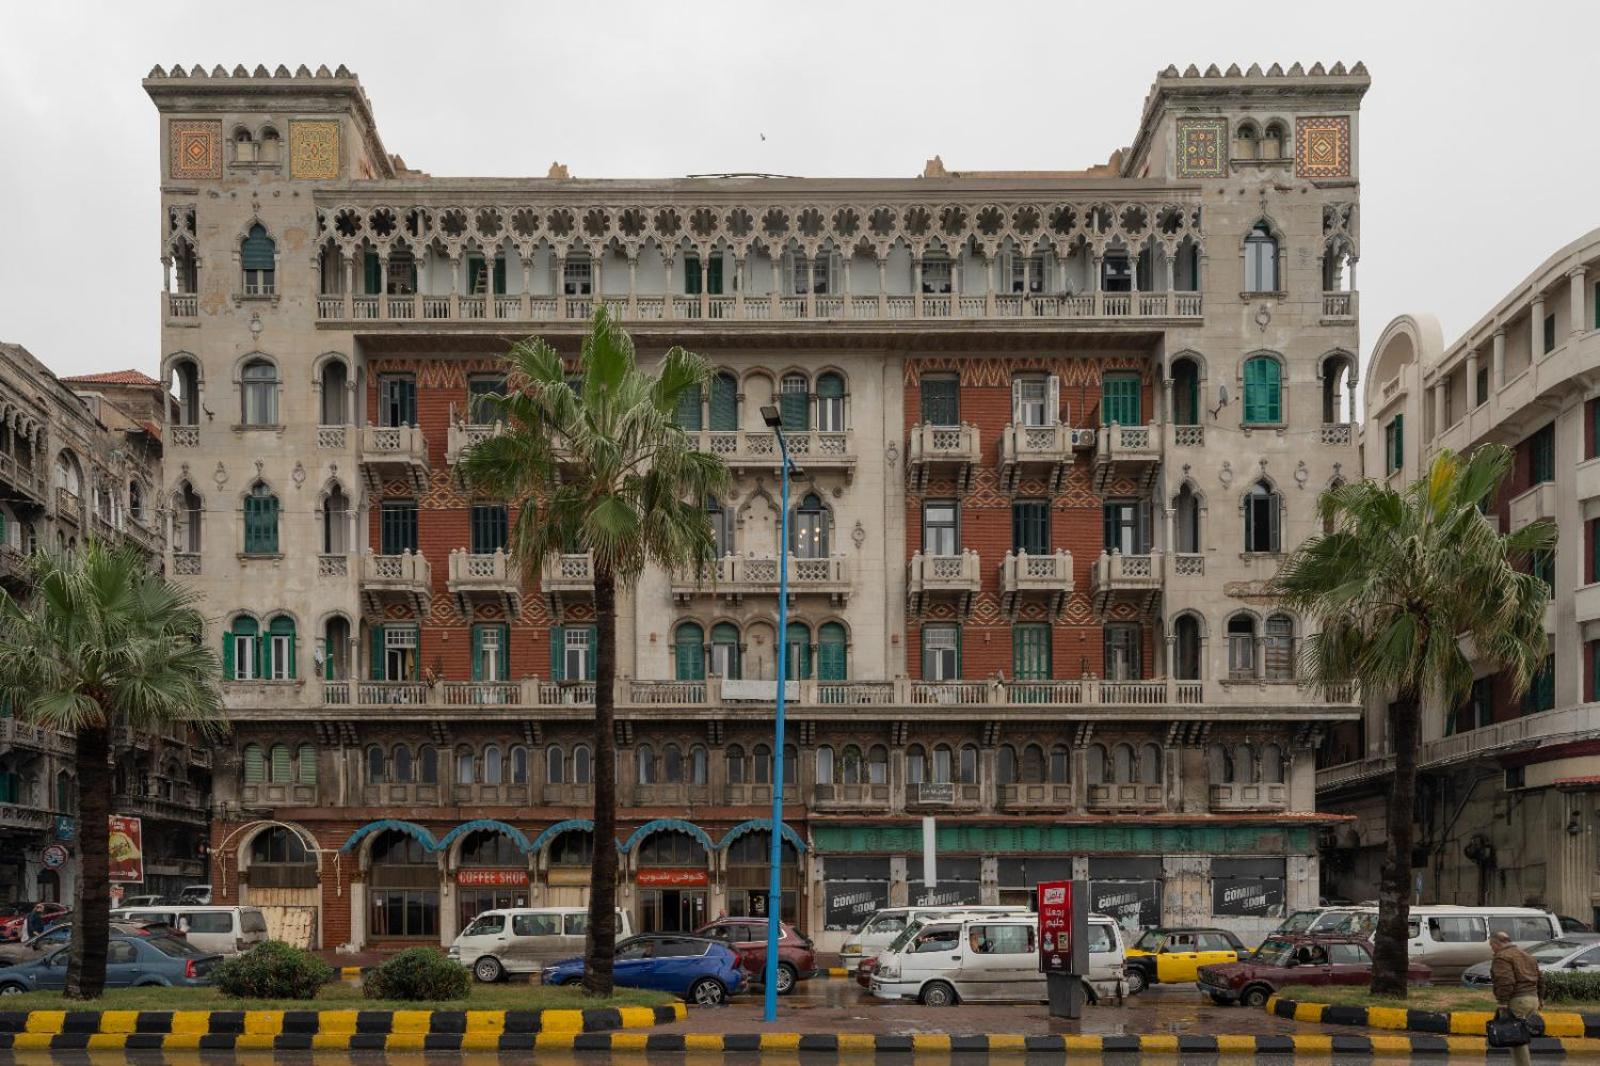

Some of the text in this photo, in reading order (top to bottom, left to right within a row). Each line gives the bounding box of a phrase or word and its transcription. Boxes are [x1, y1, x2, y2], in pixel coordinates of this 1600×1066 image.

[460, 871, 527, 883] COFFEE SHOP
[833, 891, 872, 908] COMING
[1098, 892, 1138, 909] COMING
[1224, 885, 1263, 902] COMING
[852, 901, 876, 914] SOON
[1117, 902, 1141, 915] SOON
[1242, 895, 1266, 909] SOON
